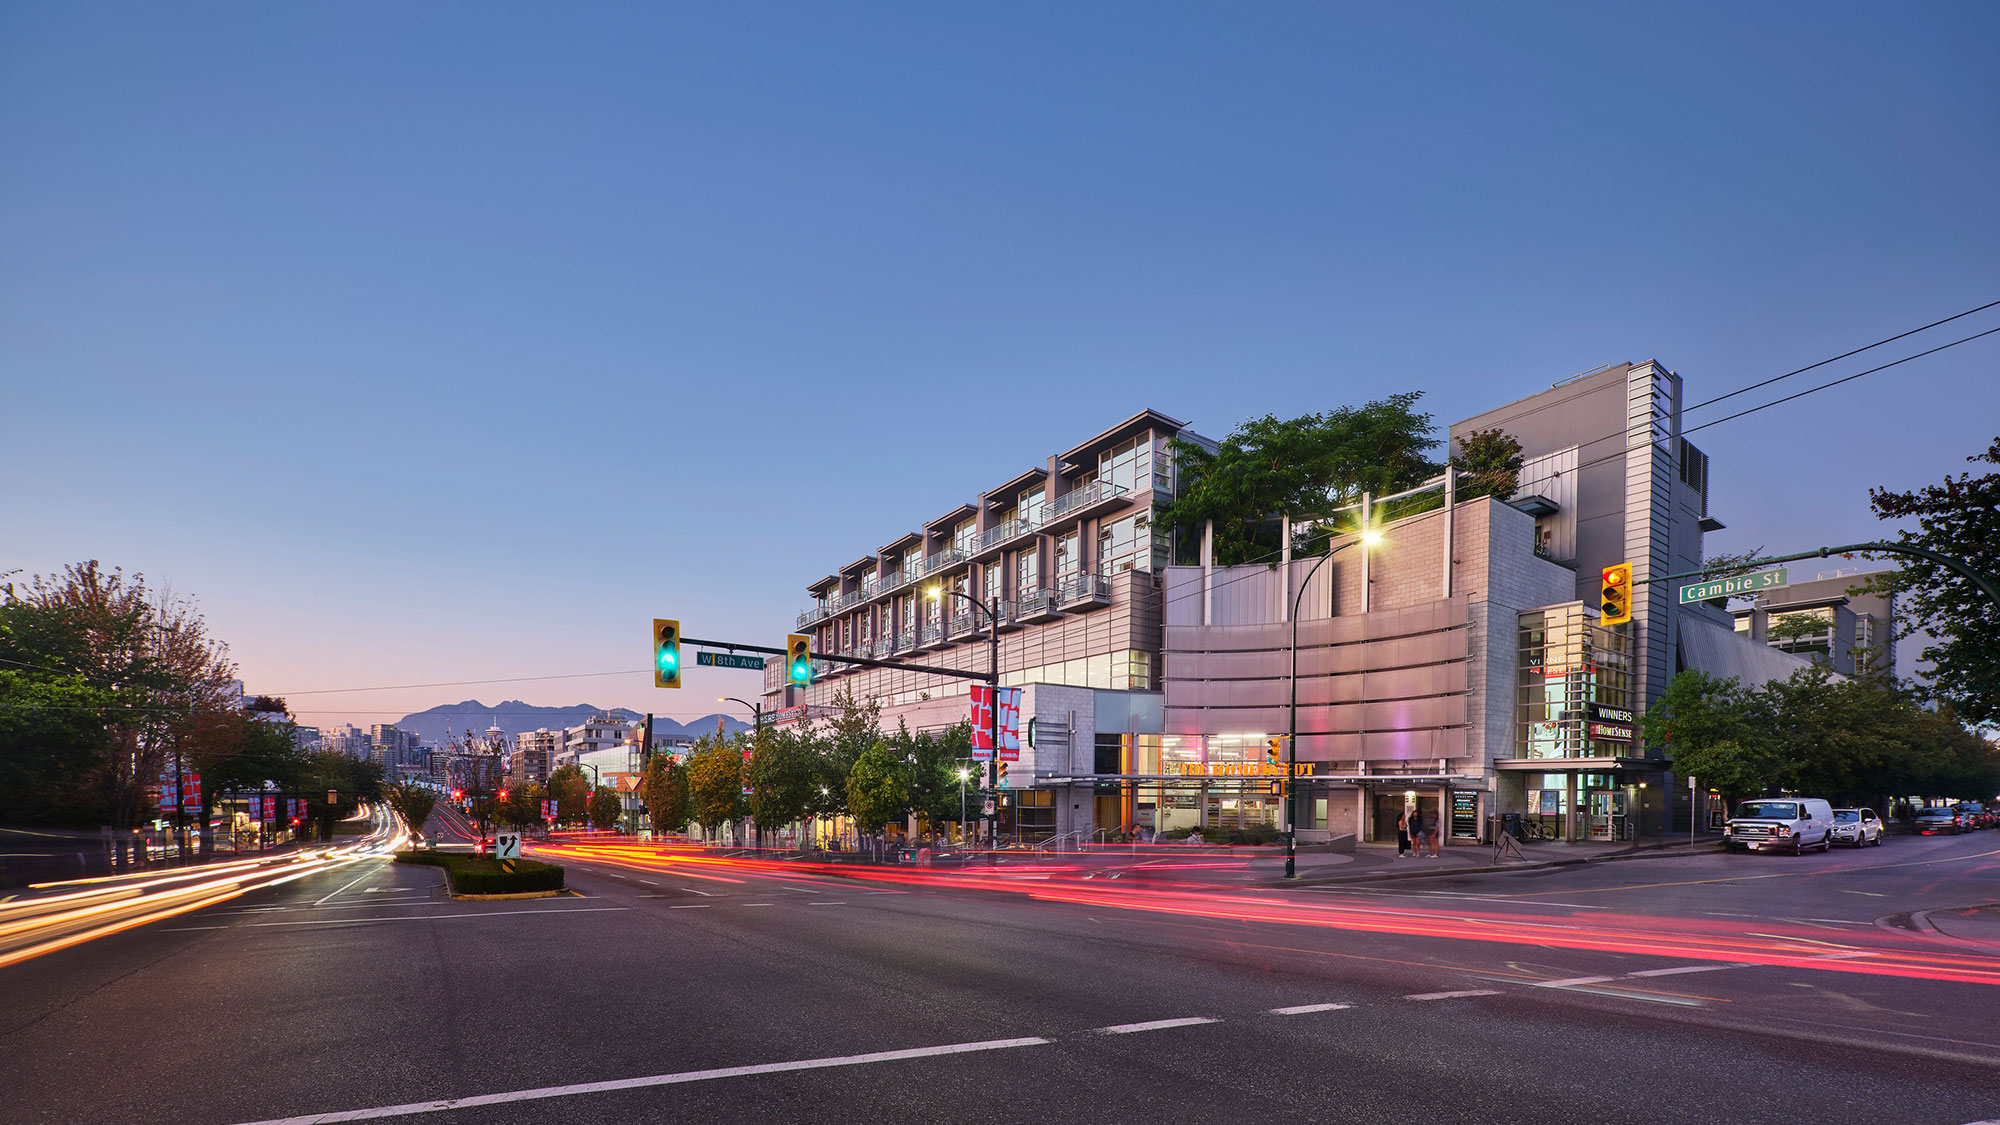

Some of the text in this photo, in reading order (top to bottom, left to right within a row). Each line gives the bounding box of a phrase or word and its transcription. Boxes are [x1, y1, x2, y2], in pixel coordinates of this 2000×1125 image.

[1687, 571, 1780, 599] Cambie St
[701, 654, 760, 668] W 8th Ave
[1598, 707, 1633, 722] WINNERS
[1180, 763, 1208, 776] THE
[1213, 763, 1258, 776] HOME
